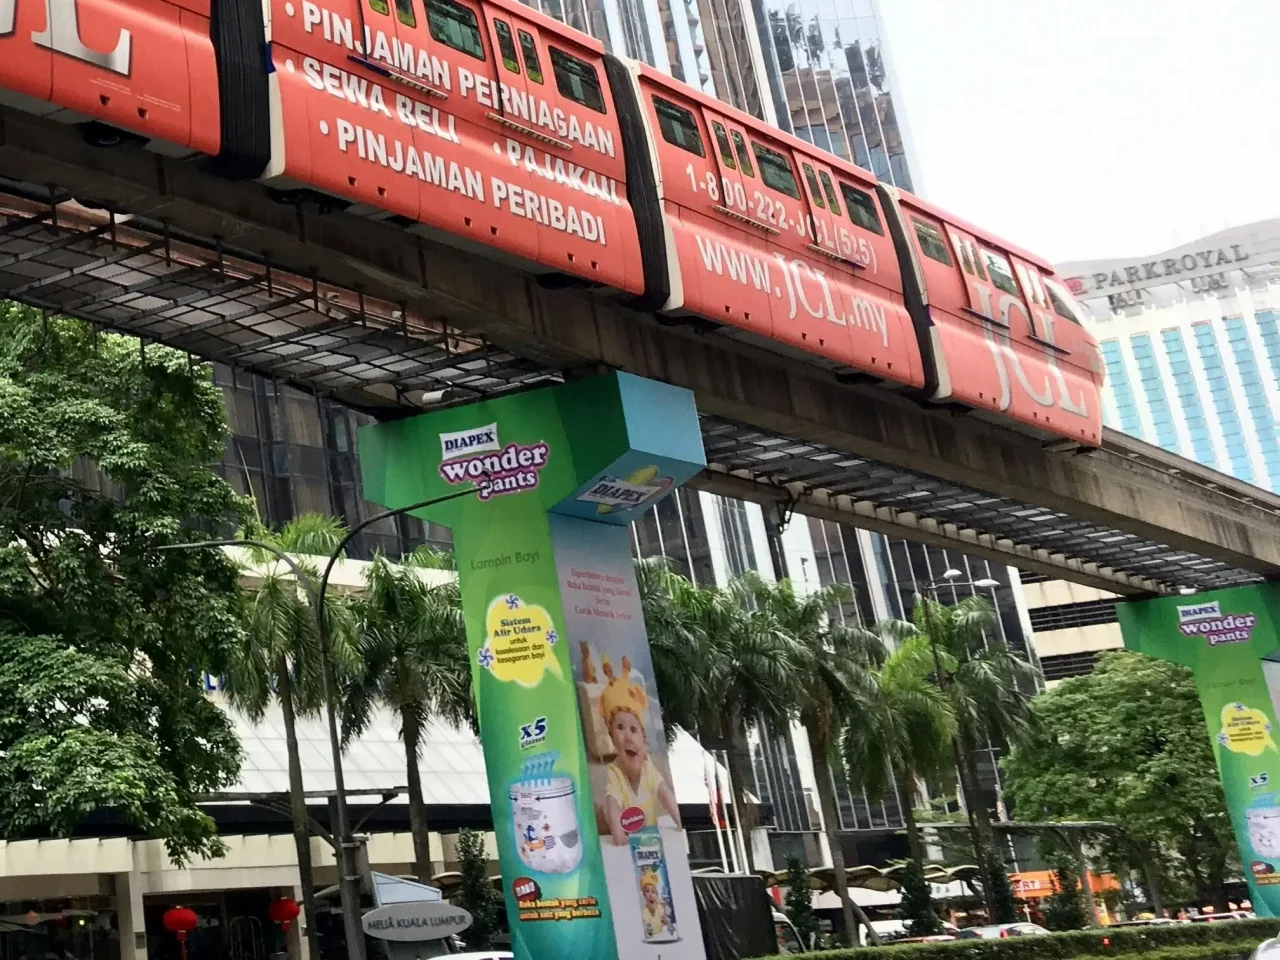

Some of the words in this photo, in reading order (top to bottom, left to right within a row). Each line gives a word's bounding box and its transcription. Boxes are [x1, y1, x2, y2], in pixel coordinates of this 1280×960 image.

[302, 0, 451, 91] PINJAMAN
[457, 66, 616, 159] PERNIAGAAN
[303, 56, 392, 118] SEWA
[396, 93, 460, 144] BELI
[507, 138, 621, 206] PAJAKAN
[336, 118, 485, 202] PINJAMAN
[491, 177, 607, 246] PERIBADI
[1092, 244, 1249, 290] PARKROYAL
[972, 282, 1089, 418] JCL
[444, 431, 495, 451] DIAPEX
[442, 445, 547, 481] wonder
[480, 471, 536, 497] pants
[470, 555, 511, 570] Lampin
[515, 551, 540, 564] Bayi
[1181, 606, 1218, 617] DIAPEX
[500, 617, 531, 627] Sistem
[513, 625, 541, 635] Udara
[1181, 615, 1255, 634] wonder
[1209, 629, 1249, 645] pants
[397, 917, 428, 929] KUALA
[430, 915, 467, 927] LUMPUR
